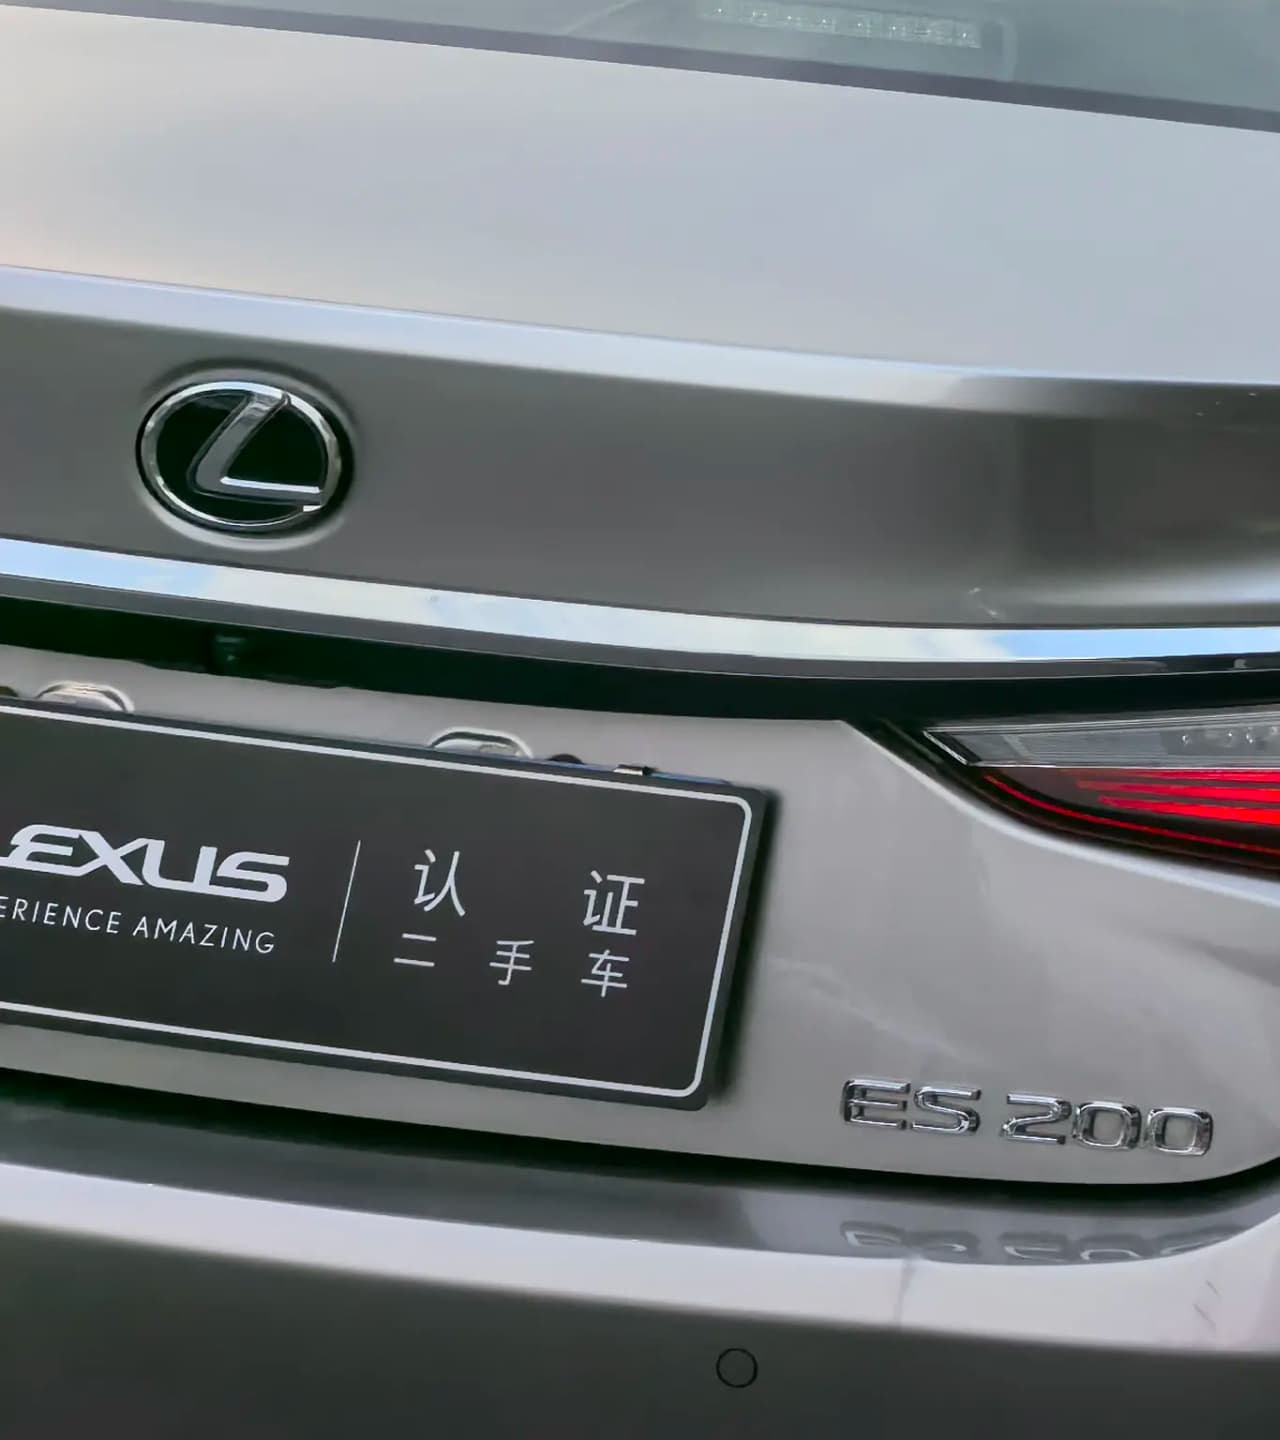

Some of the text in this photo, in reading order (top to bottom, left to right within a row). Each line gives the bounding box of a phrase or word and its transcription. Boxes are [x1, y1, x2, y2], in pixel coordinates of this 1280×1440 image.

[0, 824, 290, 903] EXUS
[132, 916, 275, 954] AMAZING
[393, 932, 629, 998] 二手车
[841, 1077, 1214, 1157] ES 200
